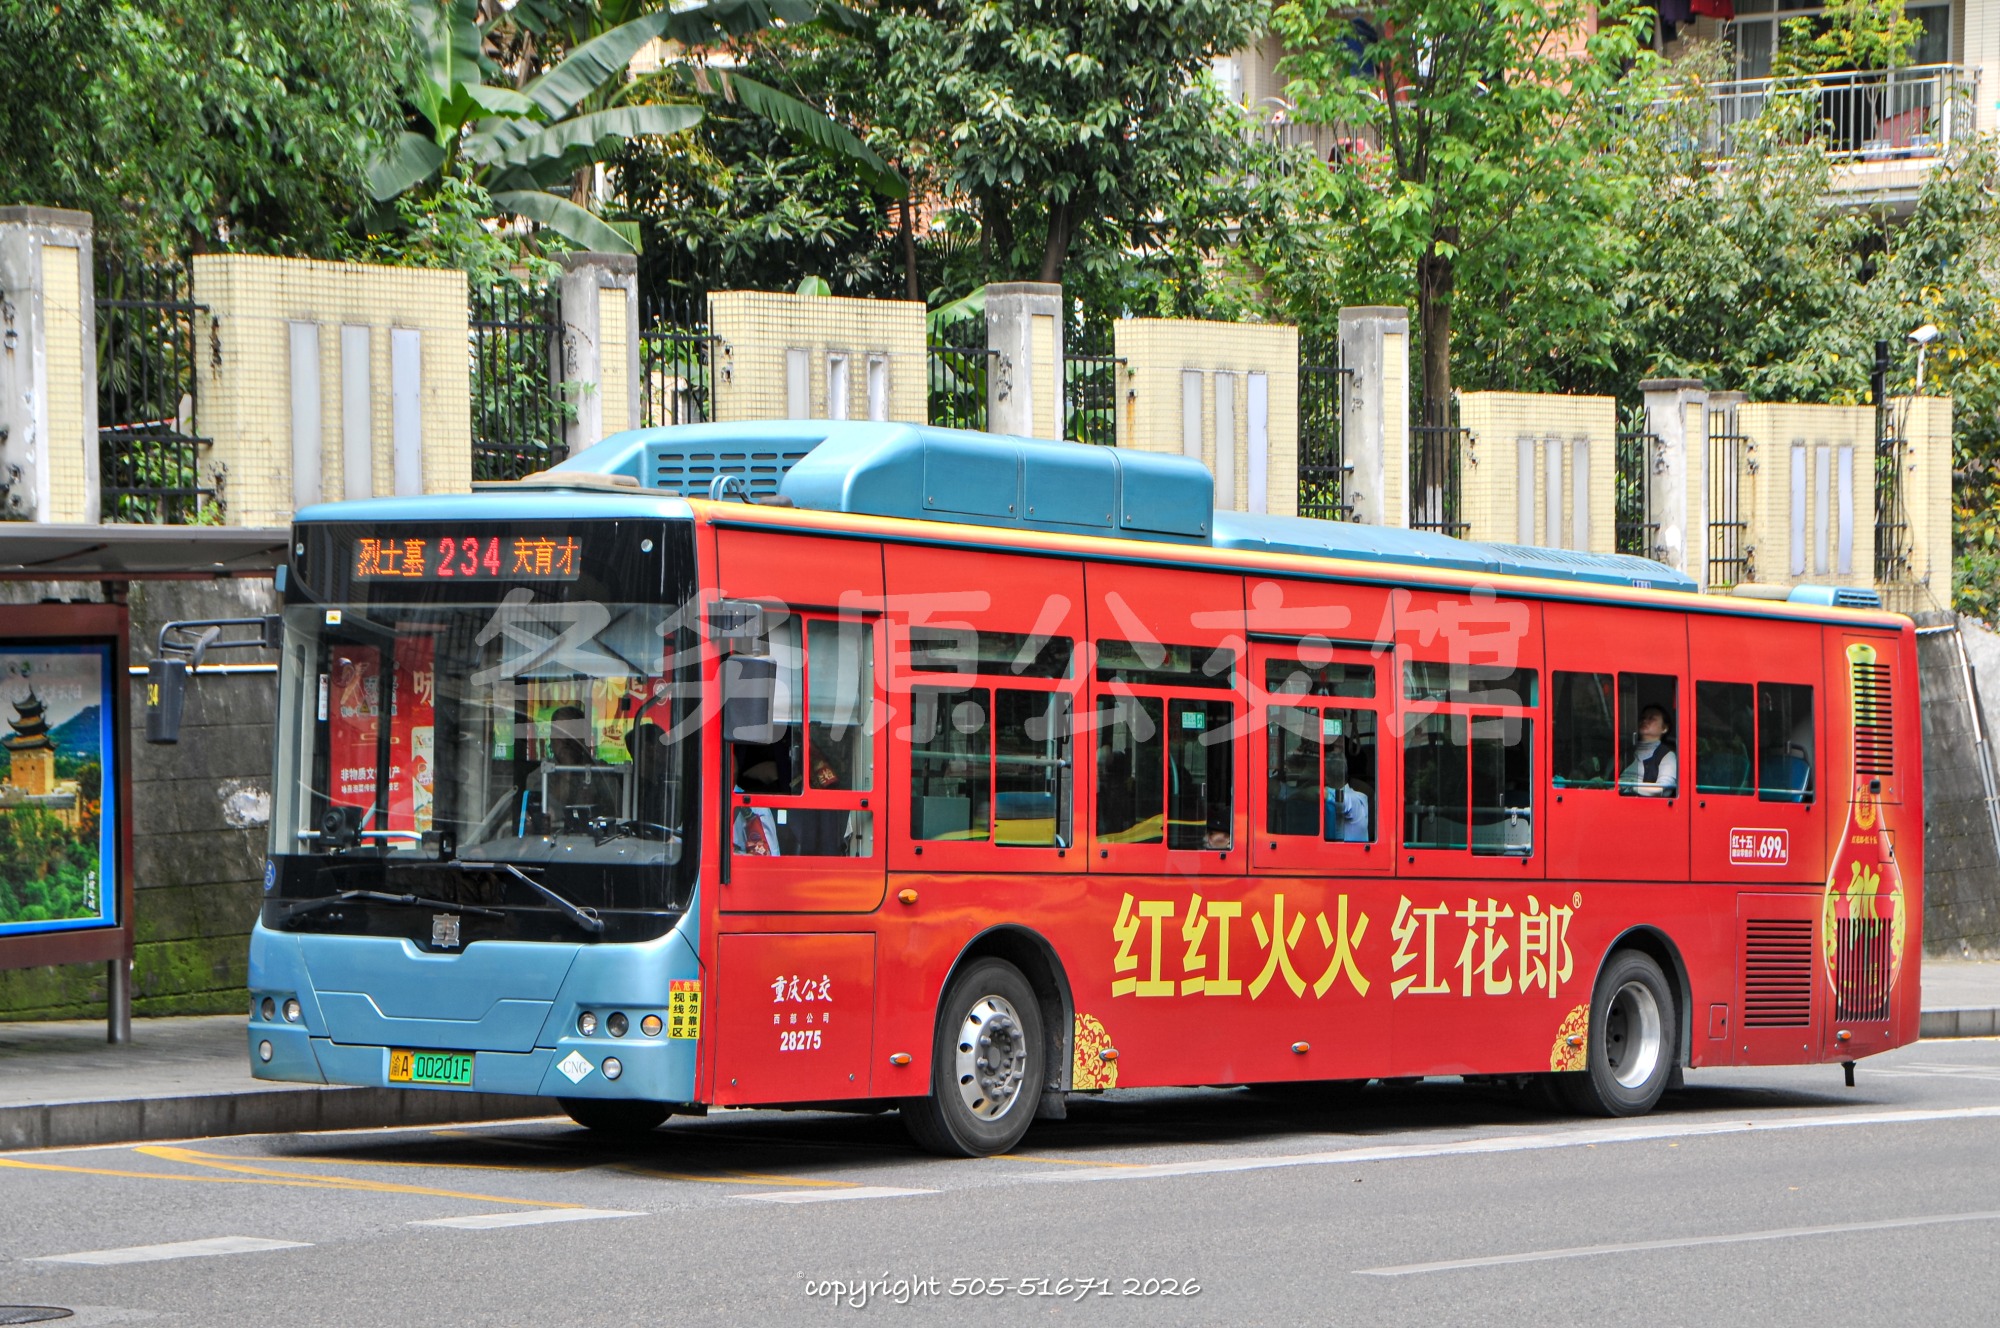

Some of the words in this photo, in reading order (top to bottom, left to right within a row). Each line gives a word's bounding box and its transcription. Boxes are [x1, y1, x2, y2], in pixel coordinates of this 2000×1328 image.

[357, 538, 427, 577] 烈士墓
[436, 536, 502, 577] 234
[341, 766, 401, 782] 非物质文产
[1732, 835, 1753, 849] 红十五
[1112, 892, 1370, 1001] 红红火火
[683, 981, 701, 992] 危险
[770, 974, 833, 1003] 重庆公交
[672, 992, 685, 1038] 视线盲区
[687, 992, 699, 1038] 请勿靠近
[773, 1012, 830, 1025] 西部公司
[779, 1030, 822, 1051] 28275
[391, 1054, 409, 1077] 渝A
[416, 1056, 471, 1081] 00201F
[562, 1059, 589, 1074] CNG
